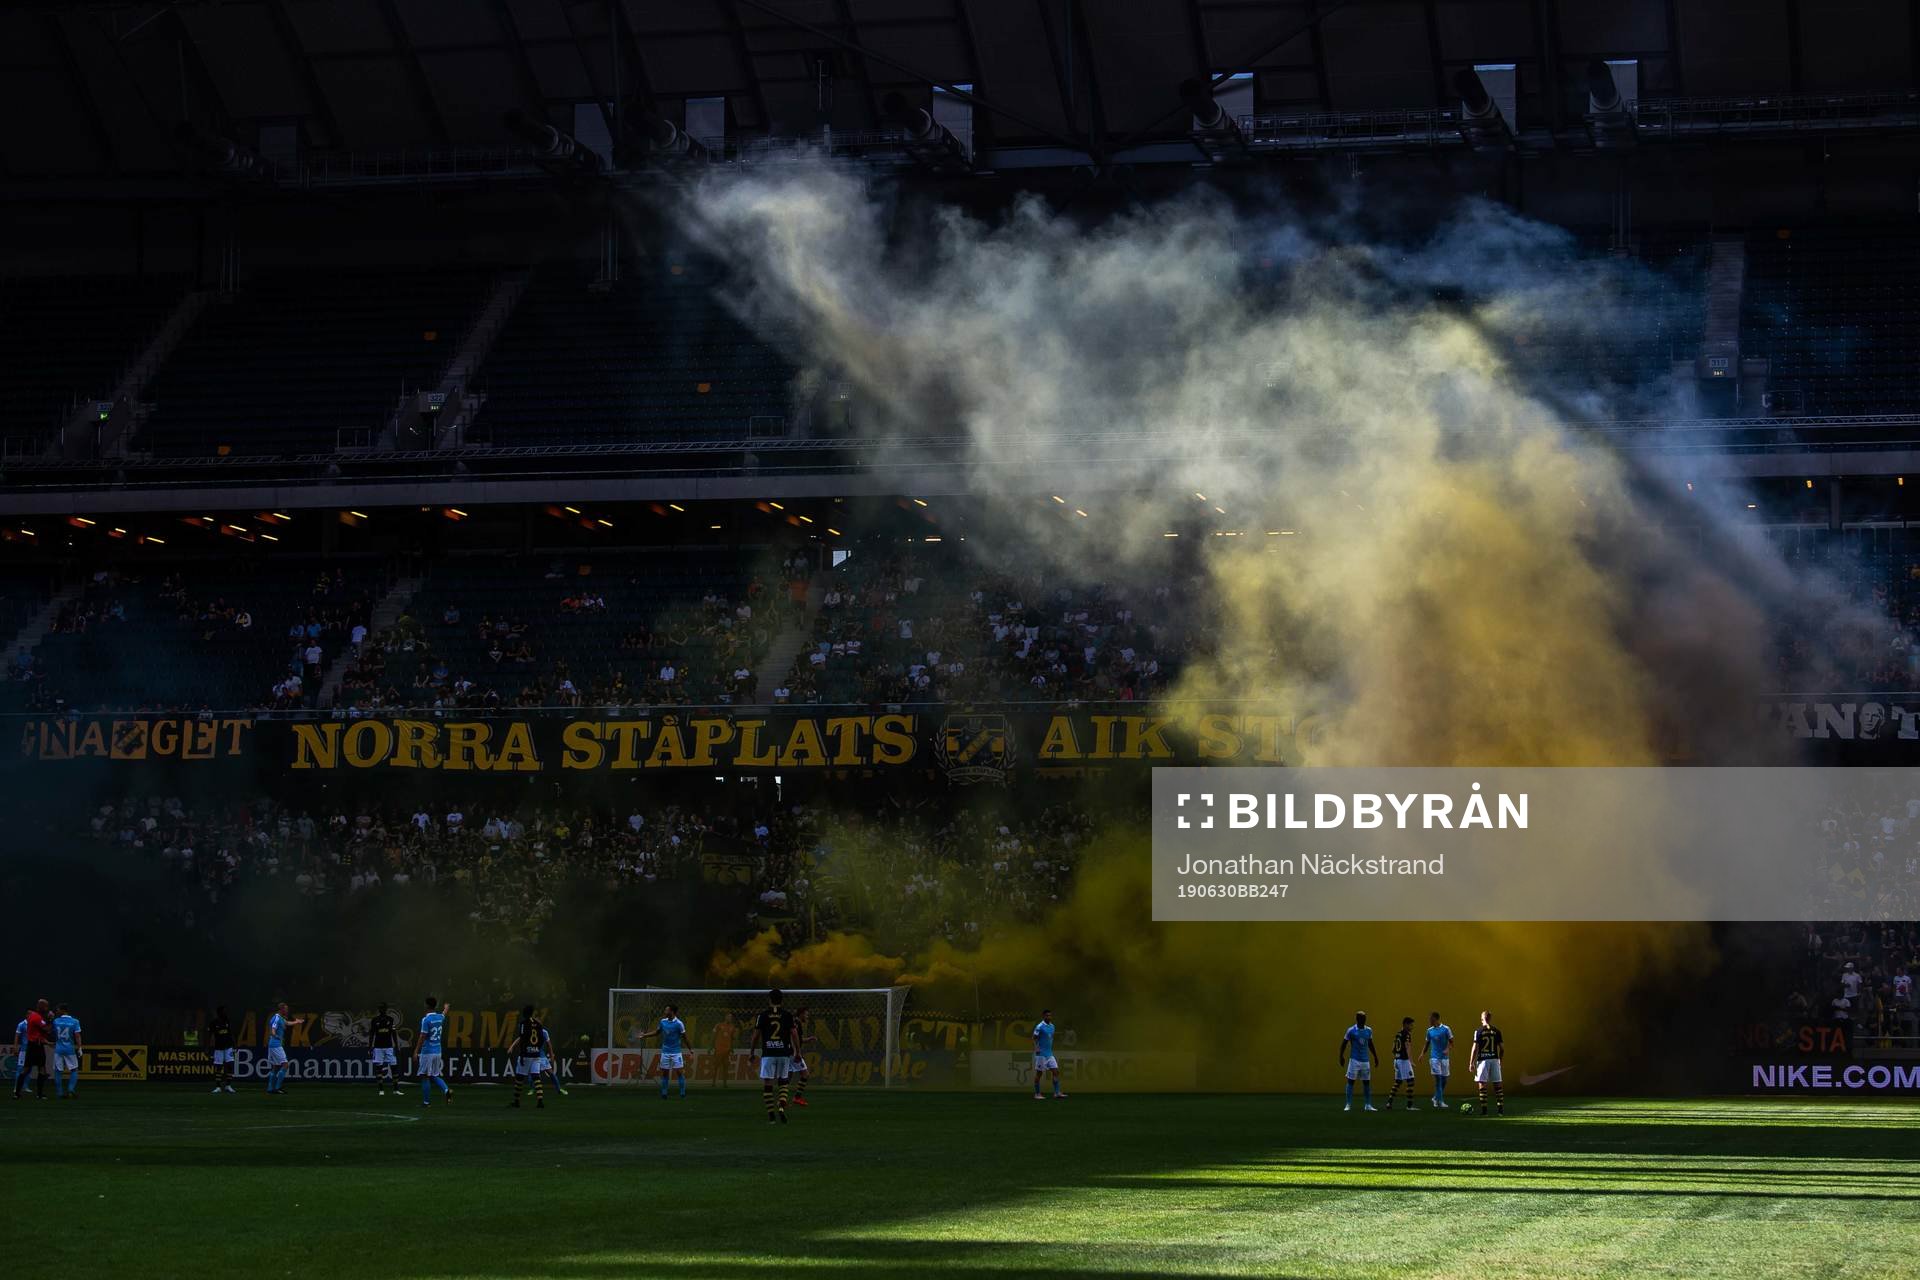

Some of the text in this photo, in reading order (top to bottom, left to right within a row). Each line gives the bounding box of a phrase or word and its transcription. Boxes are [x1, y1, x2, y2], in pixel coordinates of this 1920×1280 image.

[291, 713, 918, 771] NORRA STÅPLATS
[1039, 714, 1175, 760] AIK
[530, 1028, 538, 1046] 8
[770, 1020, 781, 1040] 2
[1480, 1035, 1495, 1052] 21
[1752, 1064, 1920, 1089] NIKE.COM
